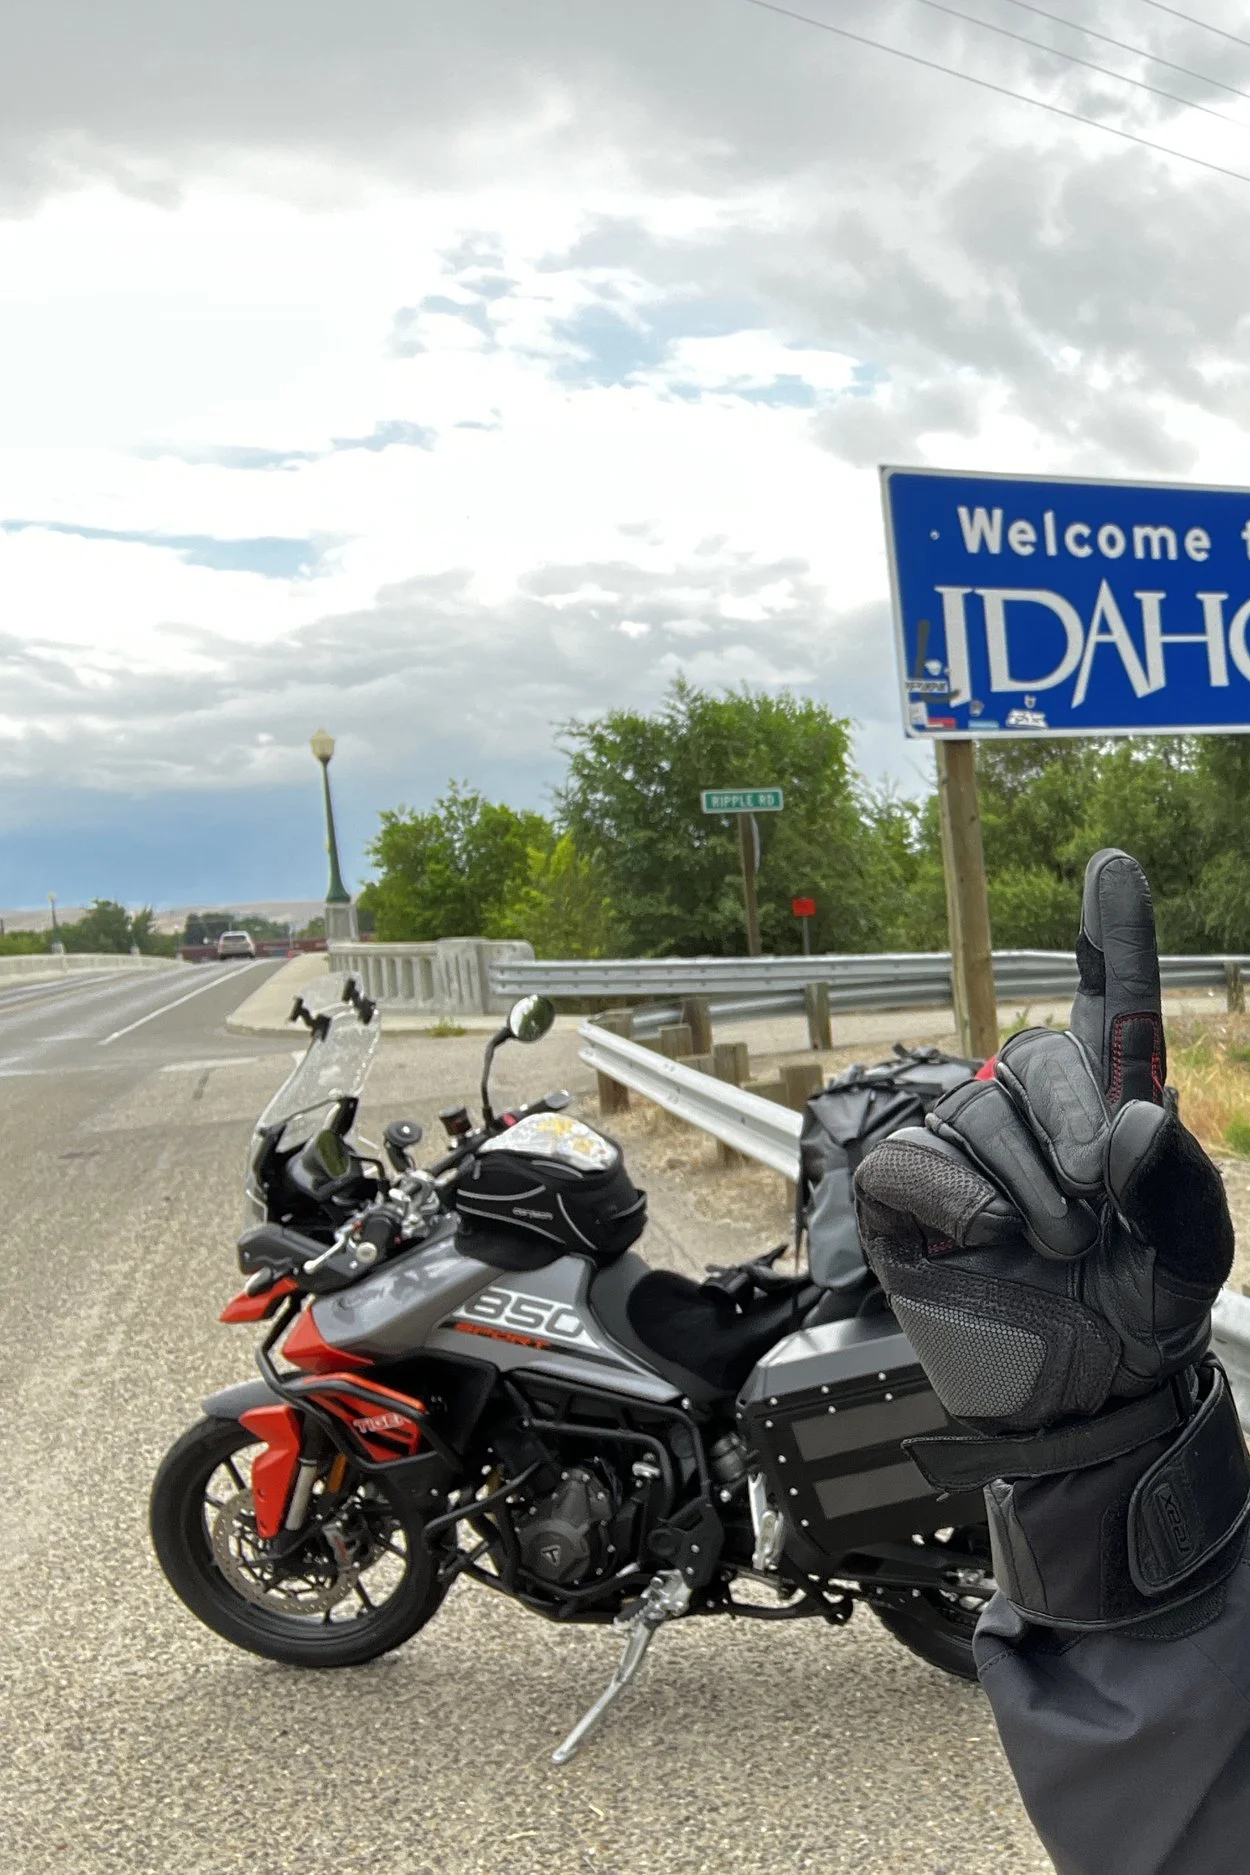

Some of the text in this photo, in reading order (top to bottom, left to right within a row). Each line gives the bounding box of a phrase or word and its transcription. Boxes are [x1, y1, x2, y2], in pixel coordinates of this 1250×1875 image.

[957, 506, 1211, 562] Welcome
[758, 793, 776, 807] RD
[463, 1285, 586, 1338] 850
